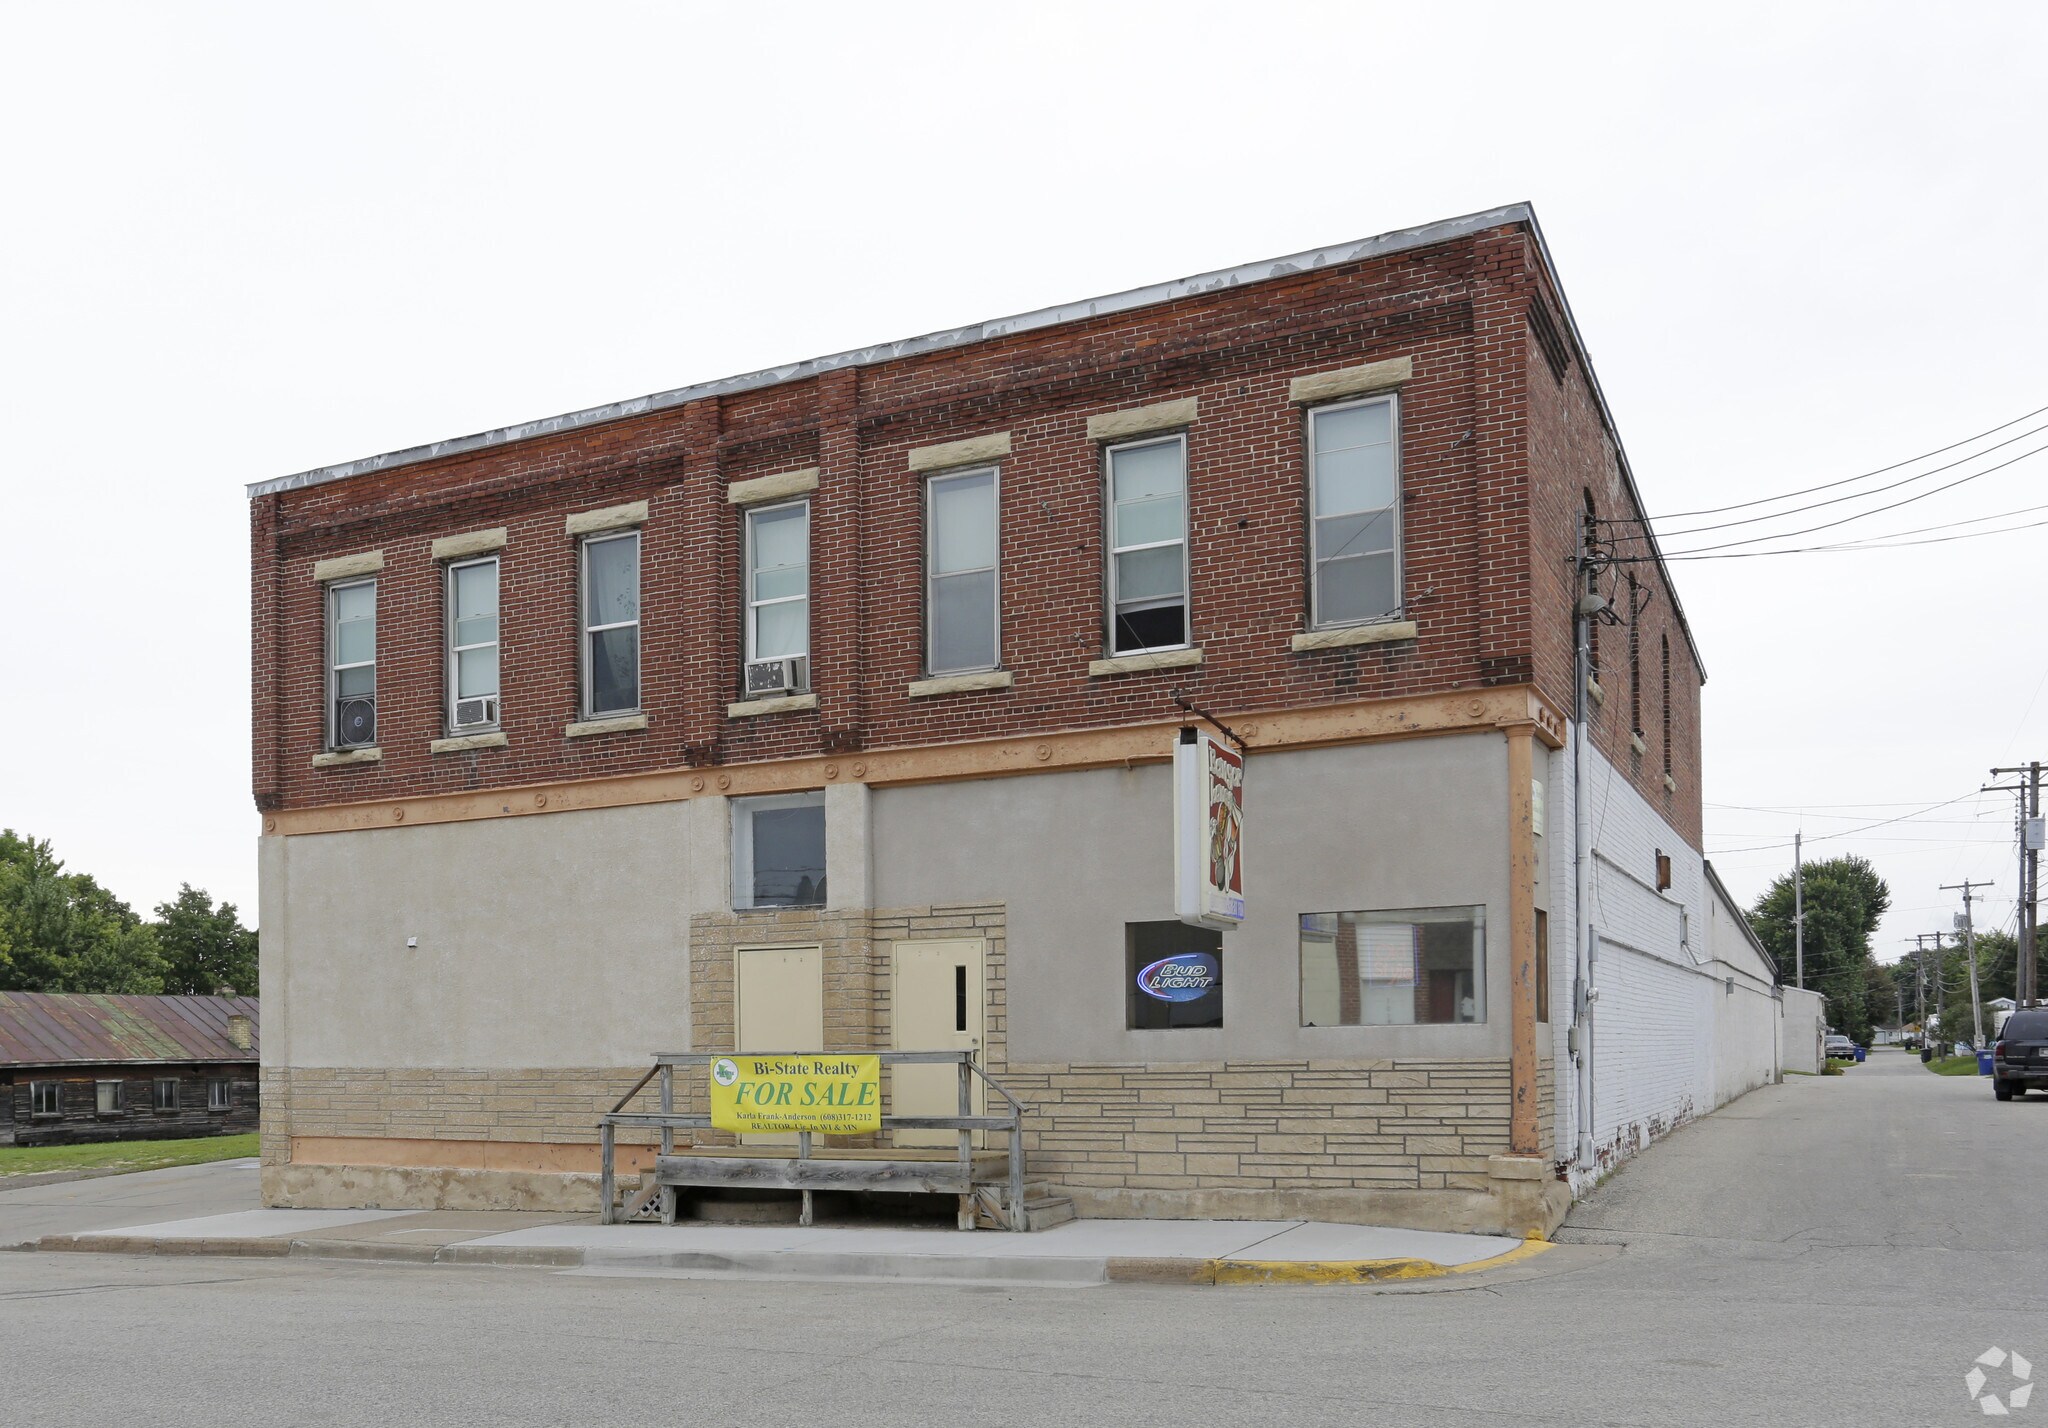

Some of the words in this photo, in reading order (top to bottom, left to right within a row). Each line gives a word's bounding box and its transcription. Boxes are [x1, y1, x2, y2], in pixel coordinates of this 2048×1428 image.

[1160, 963, 1207, 977] BUD
[1149, 976, 1213, 989] LIGHT
[754, 1061, 809, 1076] Bi-State
[814, 1061, 860, 1078] Realty
[734, 1081, 794, 1106] FOR
[800, 1081, 877, 1106] SALE
[736, 1112, 756, 1120] Karla
[757, 1112, 816, 1121] Frank-Anderson
[820, 1113, 872, 1122] (608)317-1212
